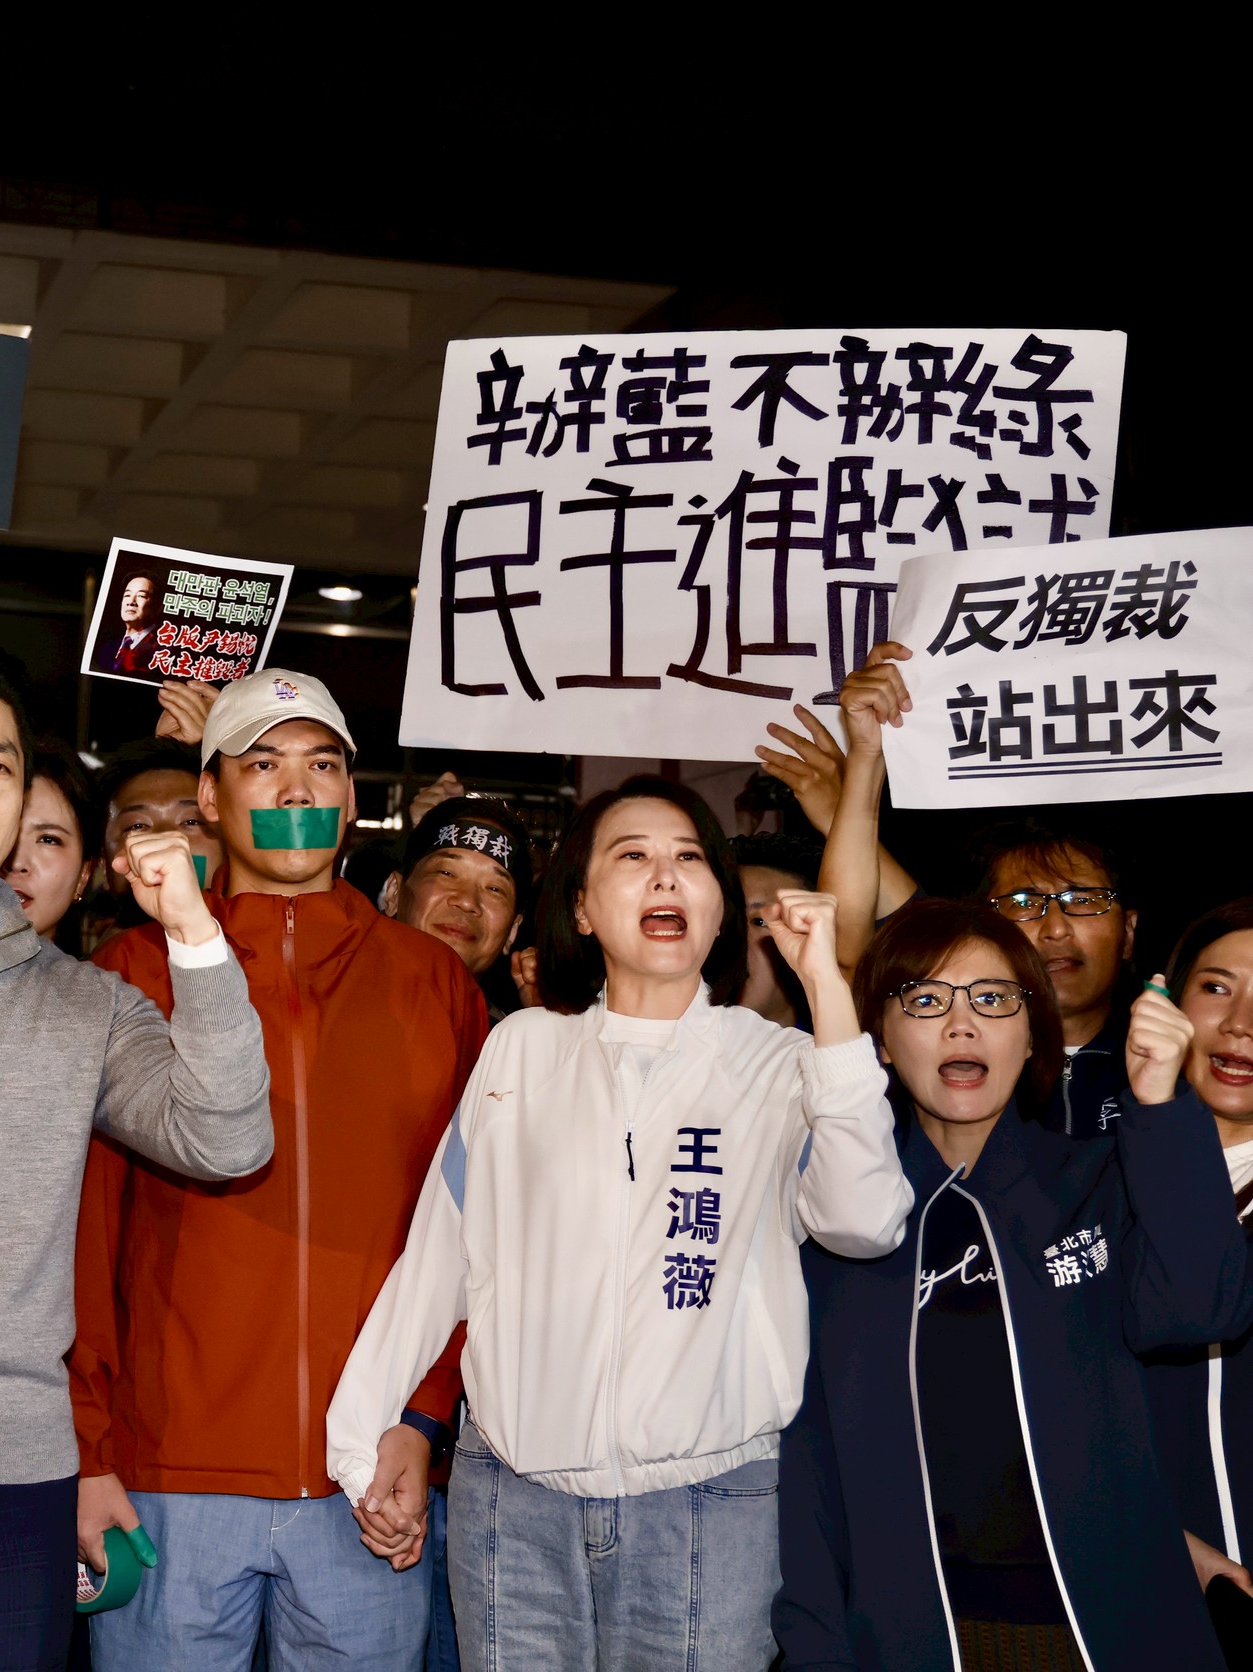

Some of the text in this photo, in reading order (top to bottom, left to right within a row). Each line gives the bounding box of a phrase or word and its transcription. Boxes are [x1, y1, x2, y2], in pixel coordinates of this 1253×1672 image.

[163, 593, 216, 621] 민주의
[167, 569, 222, 597] 대만판
[926, 560, 1198, 657] 反獨裁
[947, 669, 1221, 762] 站出來
[662, 1127, 723, 1310] 王鴻薇
